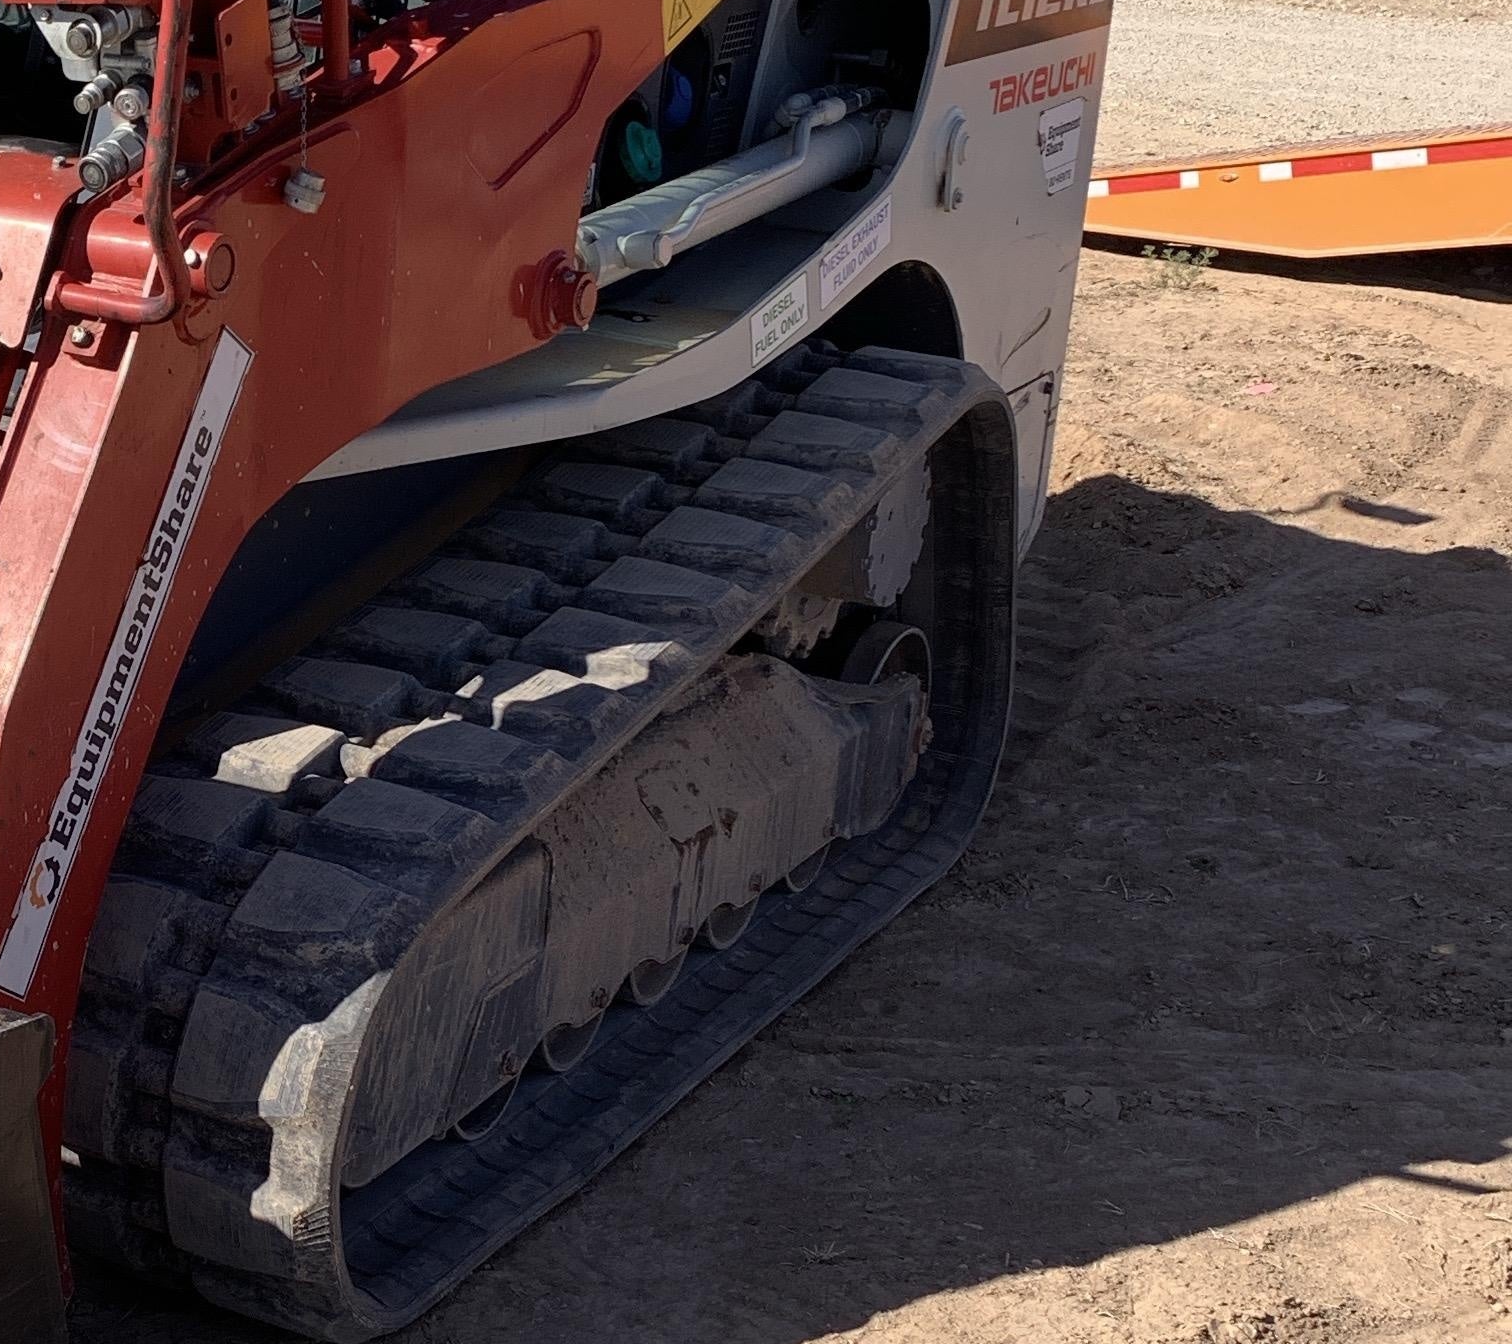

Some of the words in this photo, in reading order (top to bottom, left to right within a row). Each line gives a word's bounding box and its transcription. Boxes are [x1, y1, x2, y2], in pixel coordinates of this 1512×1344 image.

[989, 52, 1097, 115] TAKEUCHI
[822, 244, 851, 278] DIESEL
[851, 202, 890, 250] EXHAUST
[833, 258, 858, 291] FLUID
[857, 235, 879, 266] ONLY
[754, 328, 780, 358] FUEL
[780, 304, 805, 335] ONLY
[762, 291, 796, 328] DIESEL
[49, 425, 212, 852] EquipmentShare
